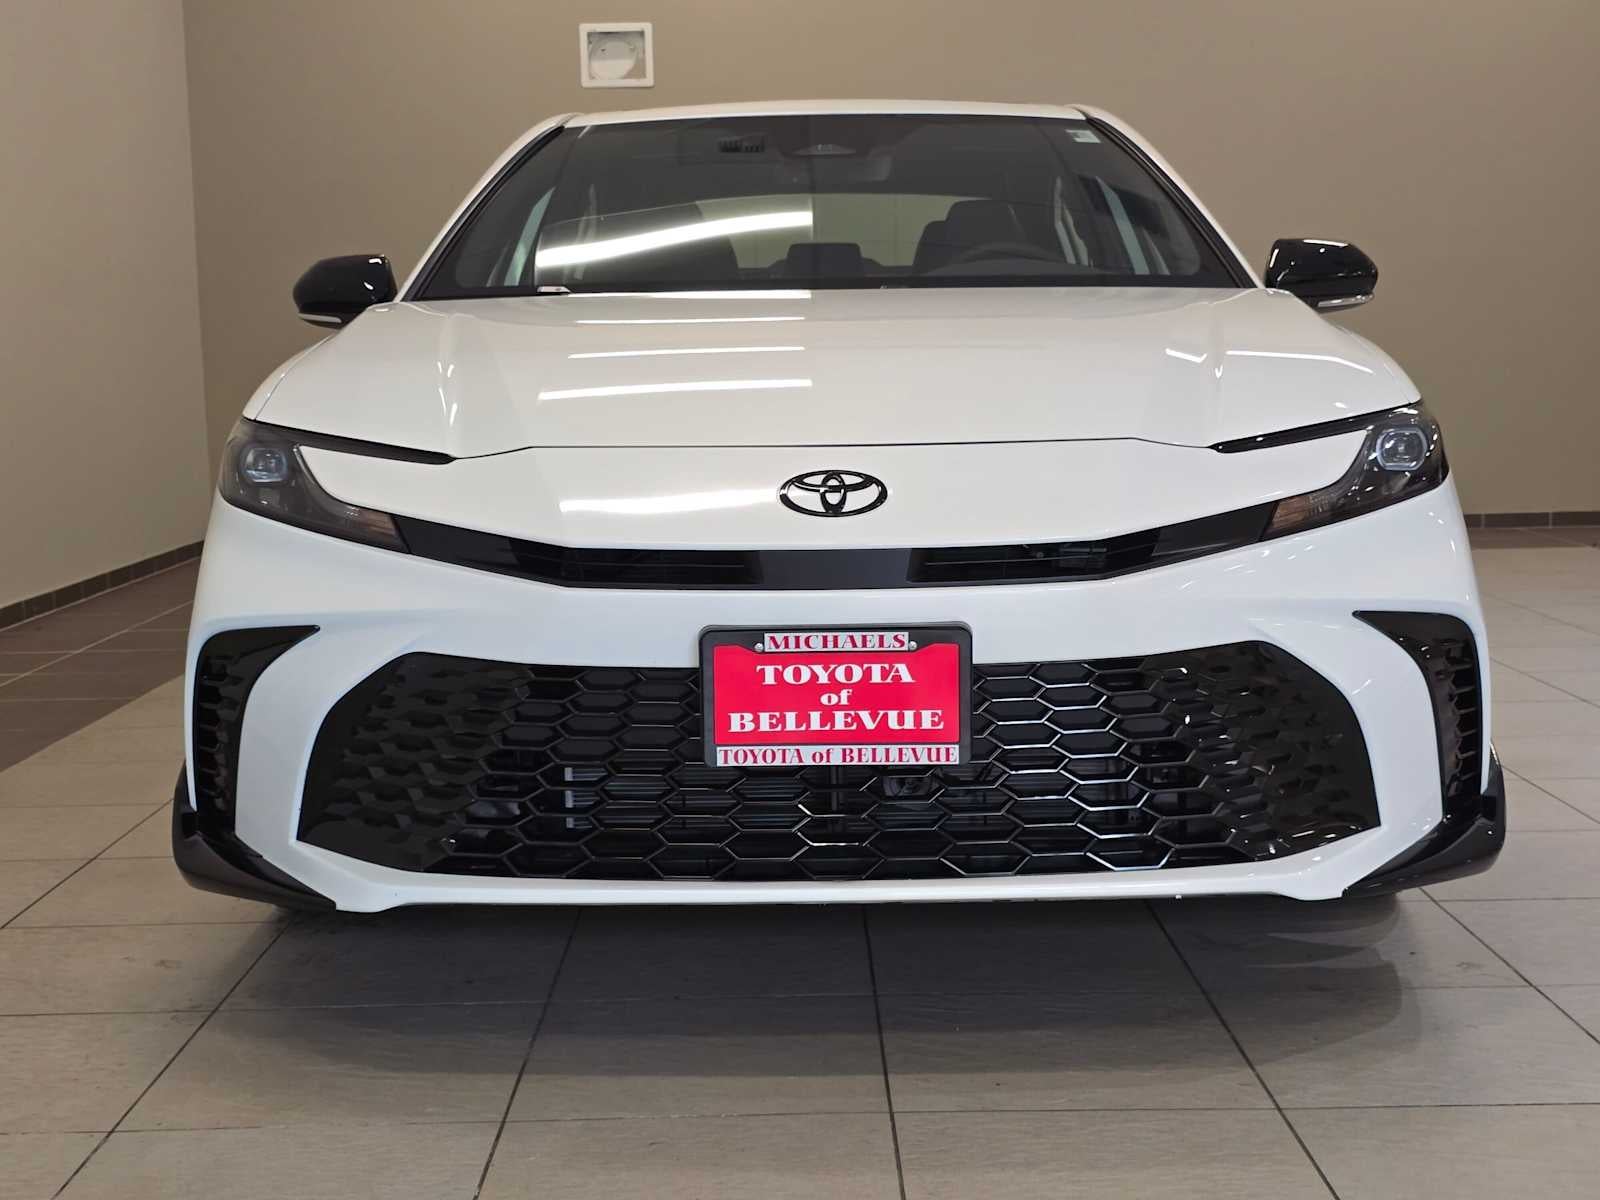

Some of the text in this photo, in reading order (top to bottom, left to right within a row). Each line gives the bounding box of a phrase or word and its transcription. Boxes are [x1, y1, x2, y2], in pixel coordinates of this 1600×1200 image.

[767, 634, 906, 650] MICHAELS
[756, 663, 915, 685] TOYOTA
[820, 689, 852, 705] of
[728, 709, 944, 732] BELLEVUE
[719, 746, 957, 765] TOYOTA of BELLEVUE
